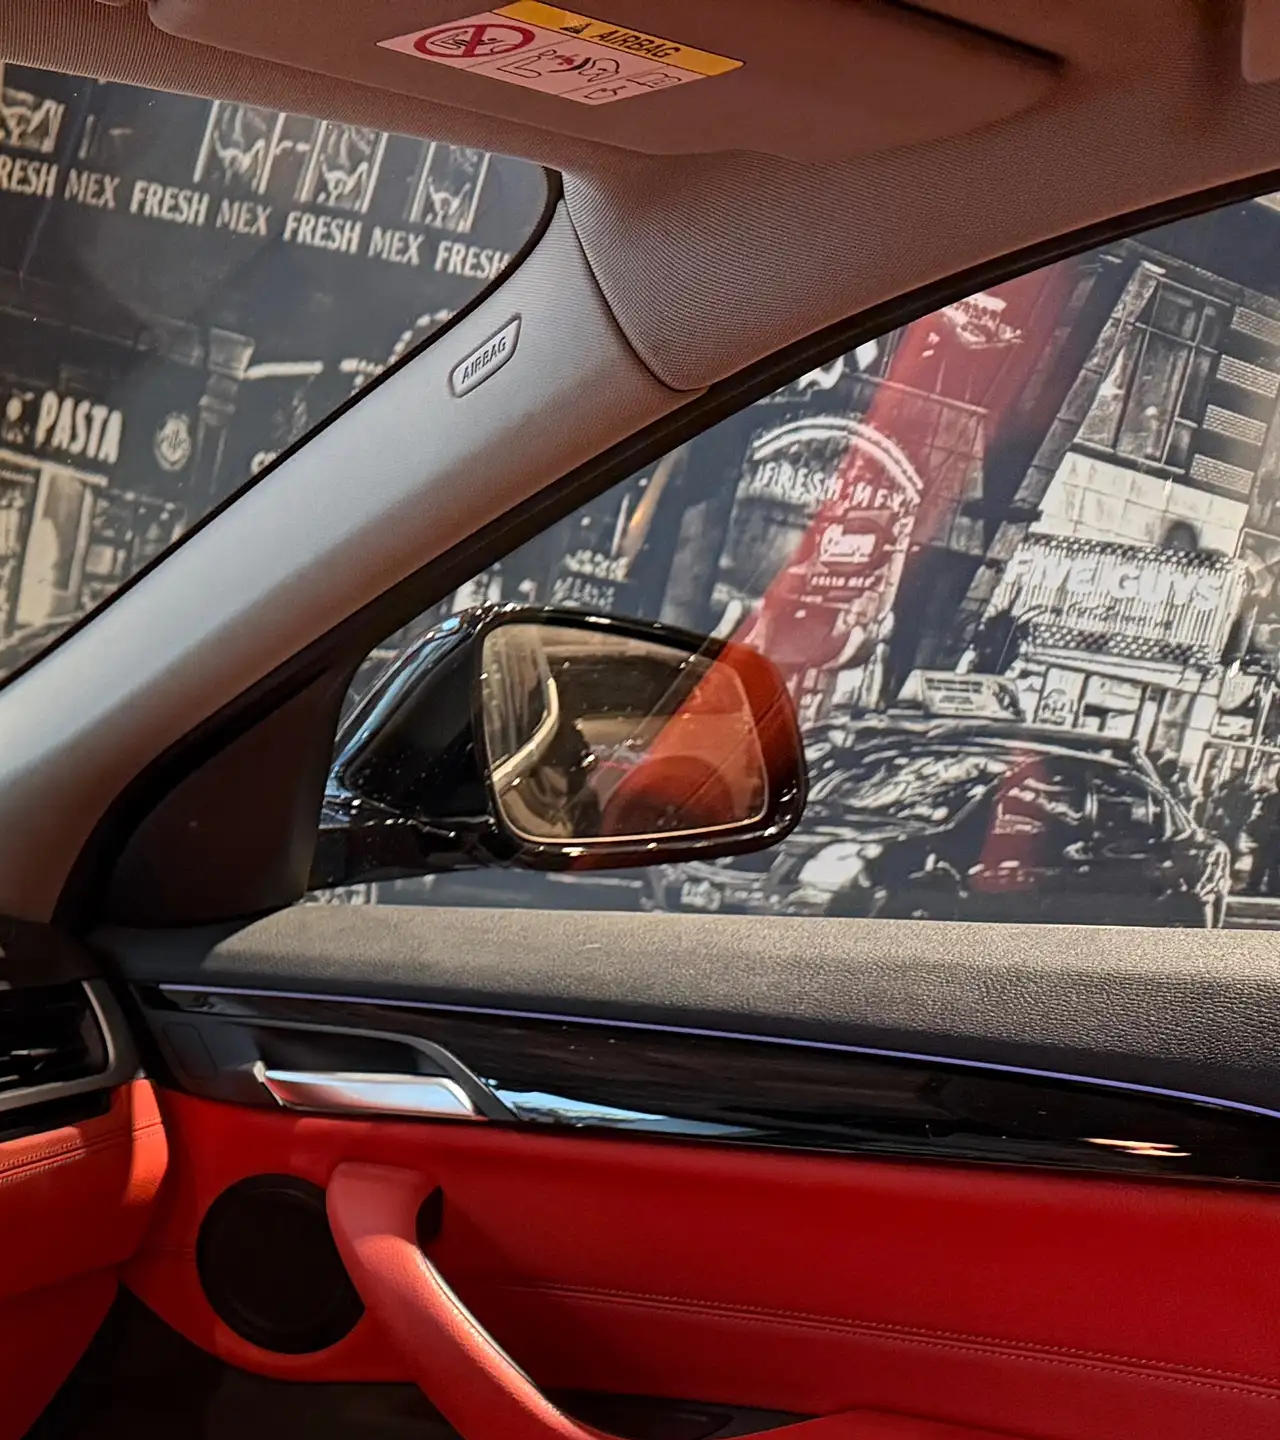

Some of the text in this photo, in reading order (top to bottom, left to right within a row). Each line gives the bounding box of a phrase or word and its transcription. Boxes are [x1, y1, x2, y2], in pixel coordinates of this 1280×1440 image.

[593, 29, 681, 60] AIRBAG
[64, 167, 121, 210] MEX
[129, 179, 210, 227] FRESH
[215, 198, 273, 237] MEX
[283, 210, 363, 254] FRESH
[368, 225, 426, 266] MEX
[460, 335, 507, 385] AIRBAG
[35, 390, 123, 466] PASTA
[1007, 553, 1225, 611] FIVE GUYS
